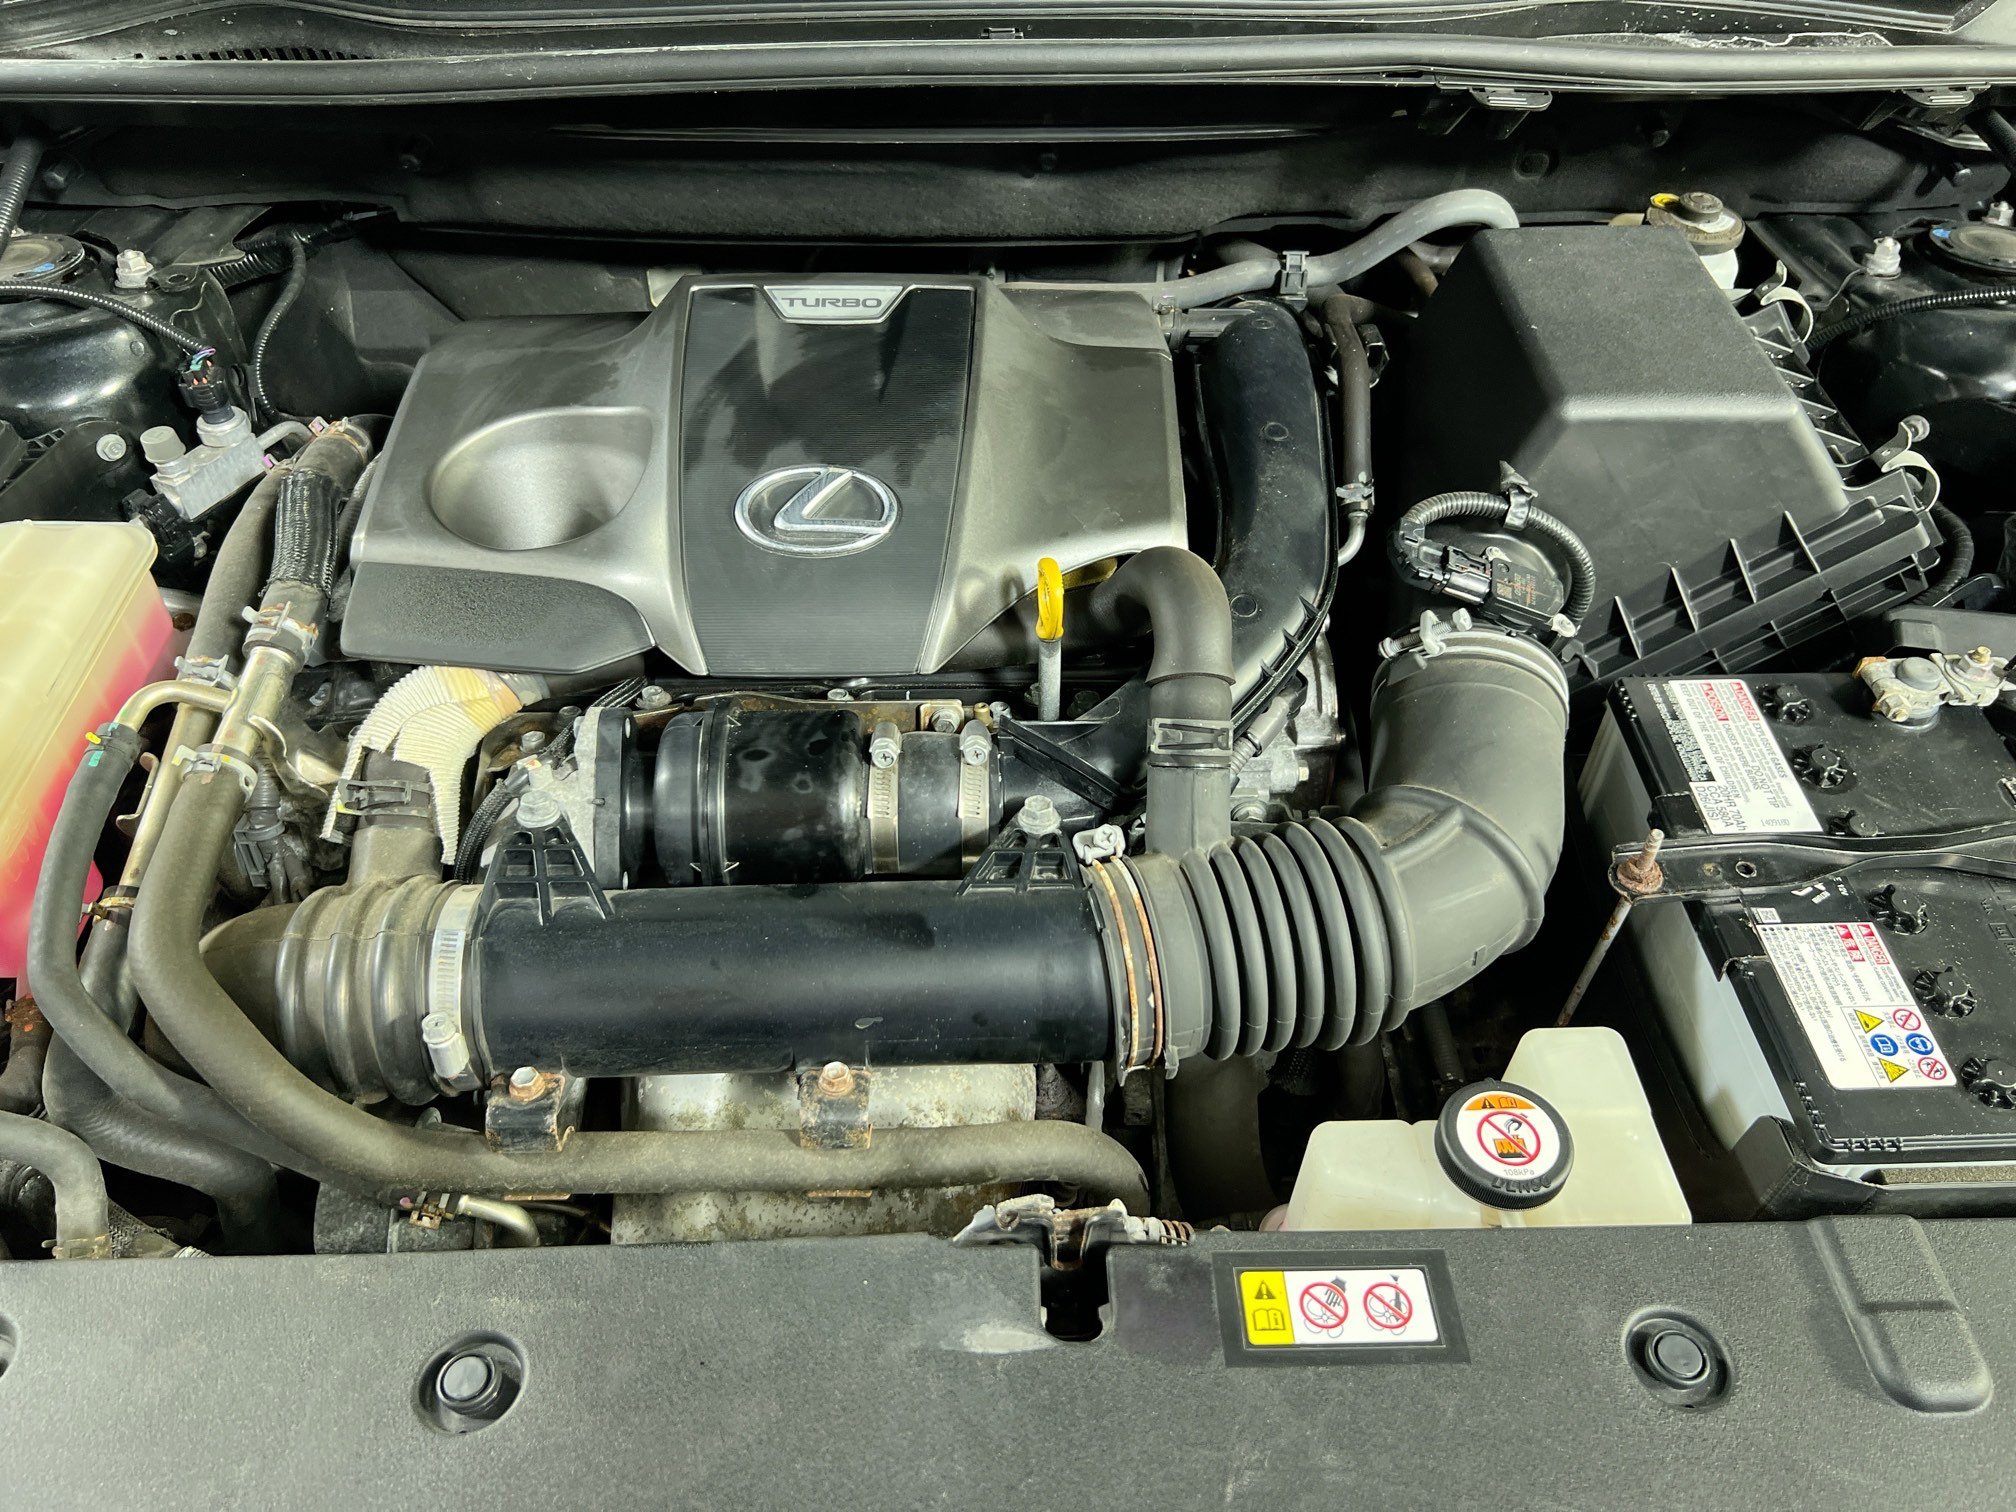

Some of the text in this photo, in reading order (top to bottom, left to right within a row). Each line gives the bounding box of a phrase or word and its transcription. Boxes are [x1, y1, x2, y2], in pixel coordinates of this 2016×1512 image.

[781, 297, 883, 308] TURBO
[1678, 684, 1741, 798] KEEP OUT OF THE REACH OF CHILDREN
[1704, 691, 1727, 718] POISON
[1721, 724, 1739, 745] CAUSES
[1733, 746, 1750, 767] SEVERE
[1744, 769, 1762, 790] BURNS
[1734, 690, 1758, 719] DANGER
[1751, 723, 1776, 755] EXPLOSIVE
[1770, 757, 1788, 778] GASES
[1706, 786, 1734, 826] CCA 580A
[1750, 765, 1780, 807] DO NOT TIP
[1717, 785, 1737, 807] 20HR
[1729, 810, 1748, 830] 70Ah
[1841, 938, 1864, 960] 危険
[1863, 936, 1888, 963] DANGER
[1503, 1168, 1535, 1177] 108kPa
